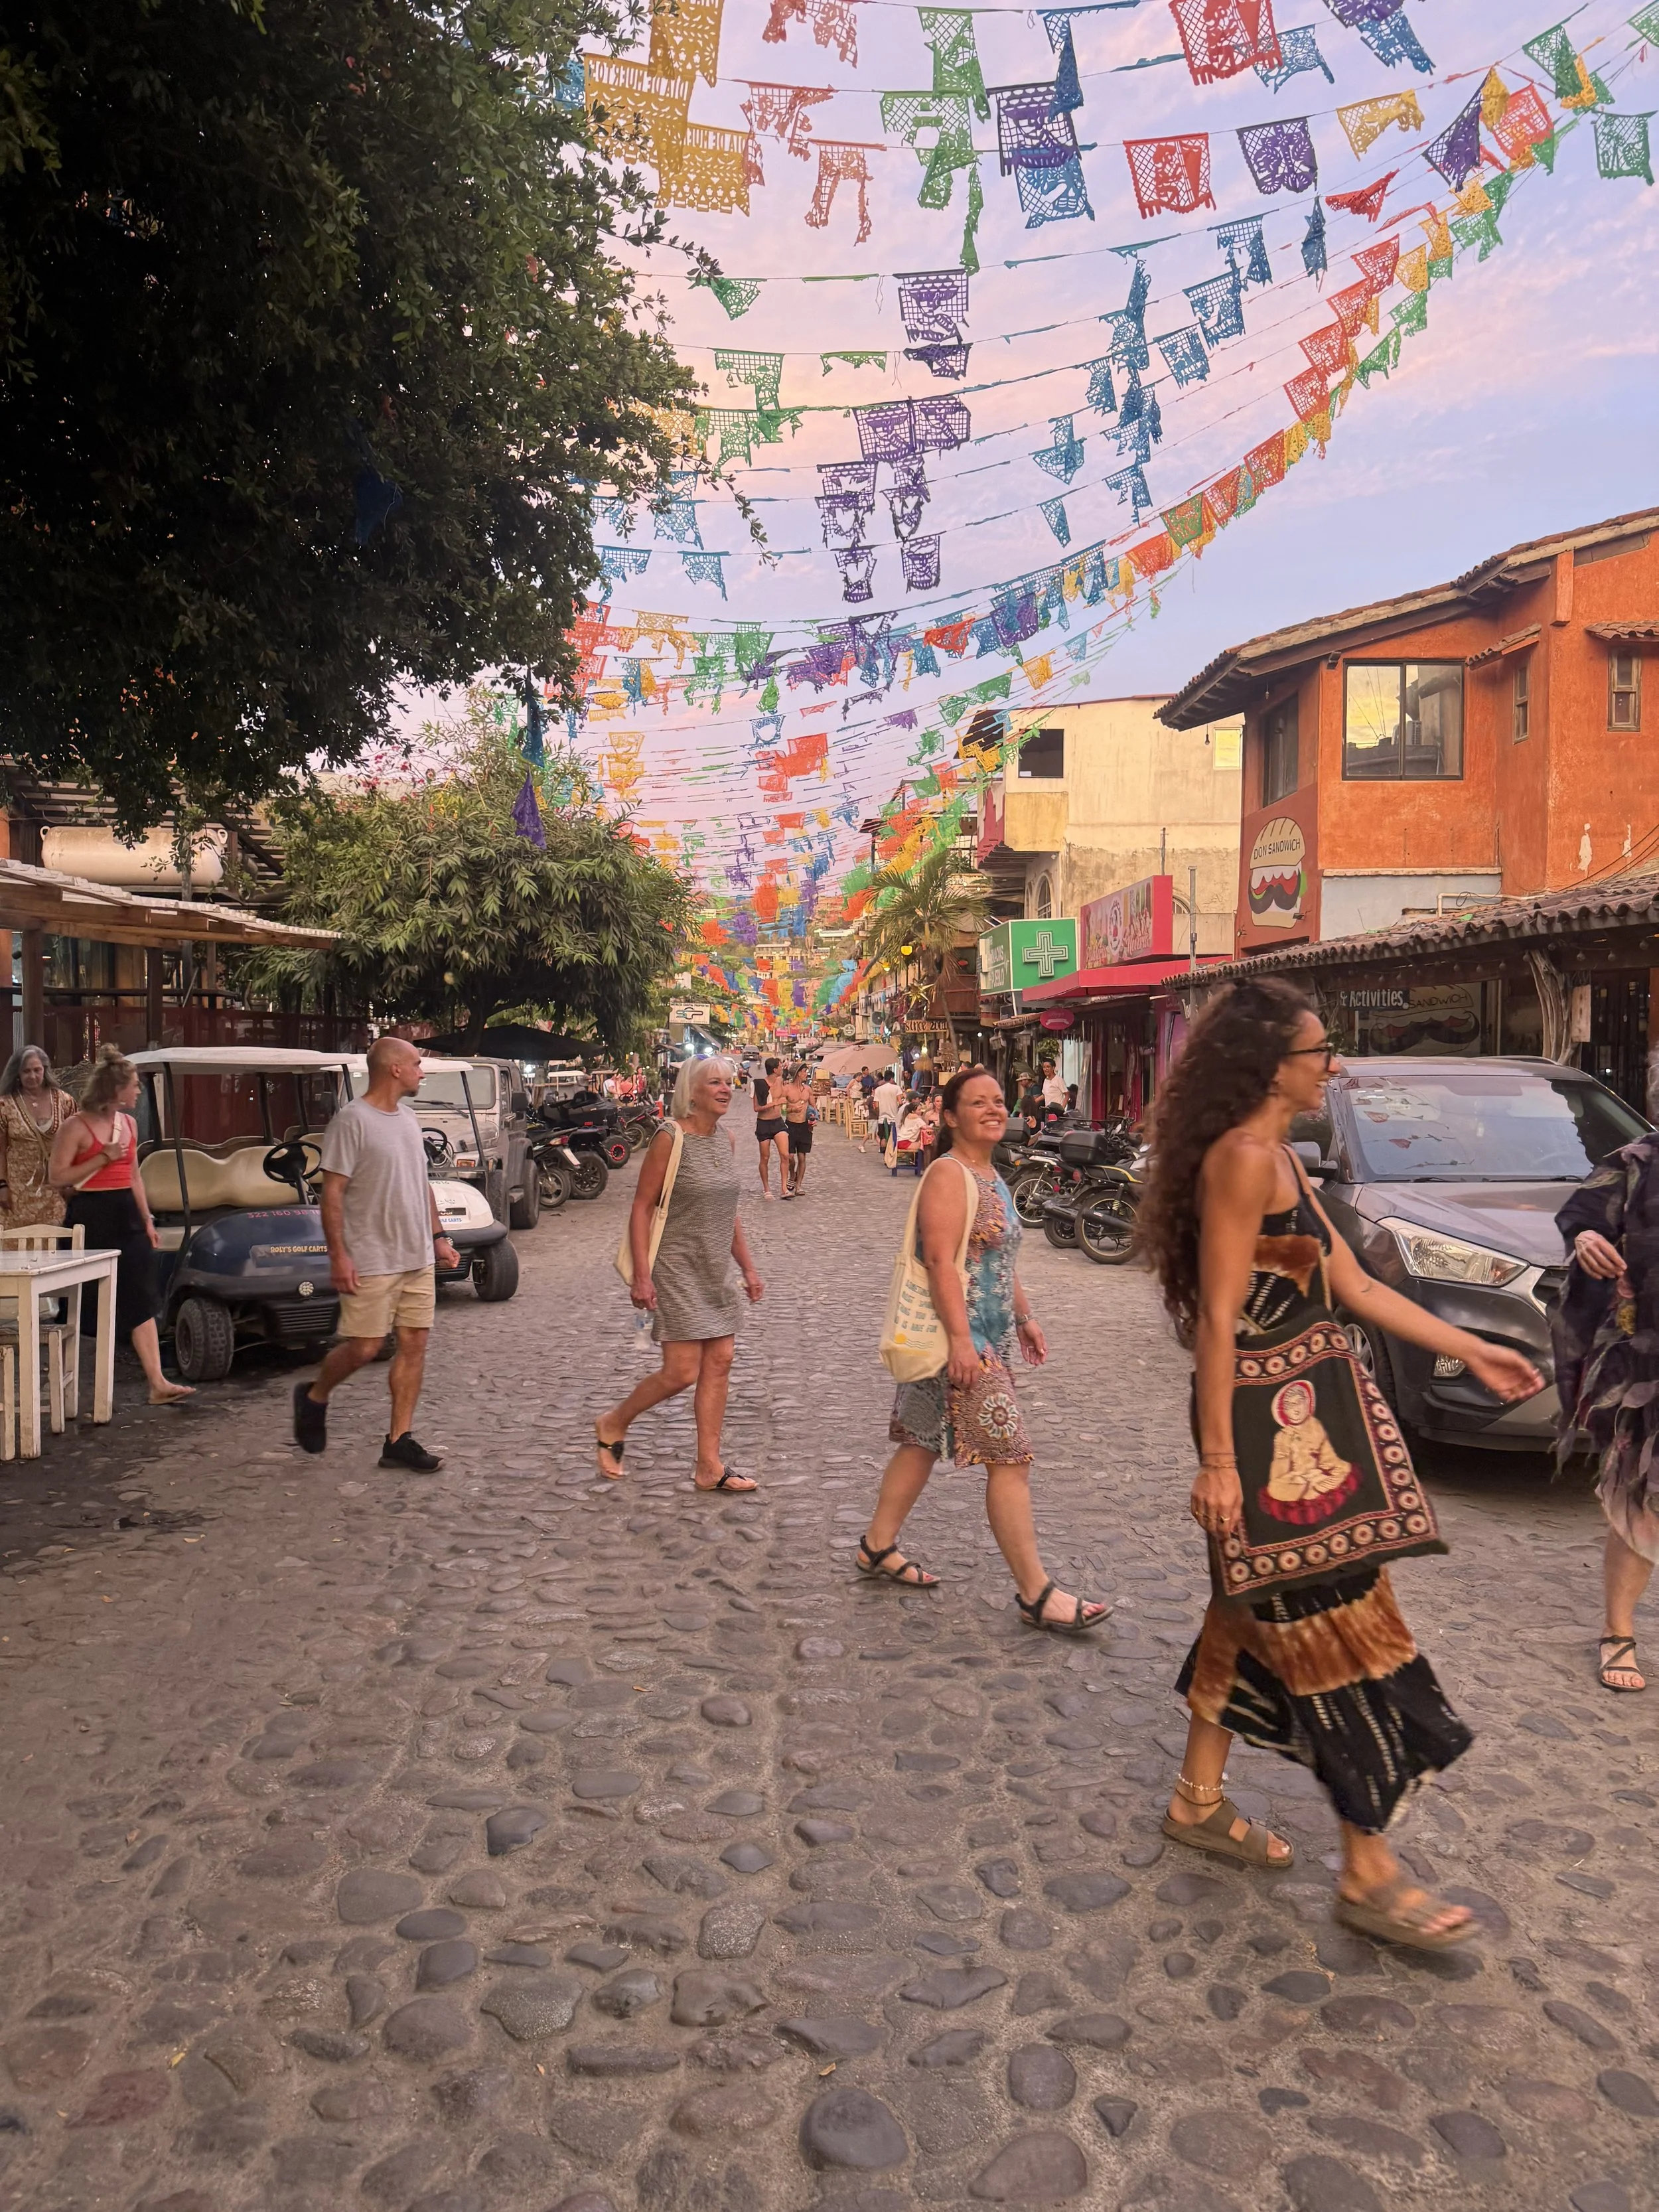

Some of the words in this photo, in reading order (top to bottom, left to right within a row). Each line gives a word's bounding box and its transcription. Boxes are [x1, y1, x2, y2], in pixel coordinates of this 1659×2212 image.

[1254, 844, 1267, 860] DON
[1268, 838, 1300, 855] SANDWICH
[1408, 994, 1468, 1009] SANDWICH
